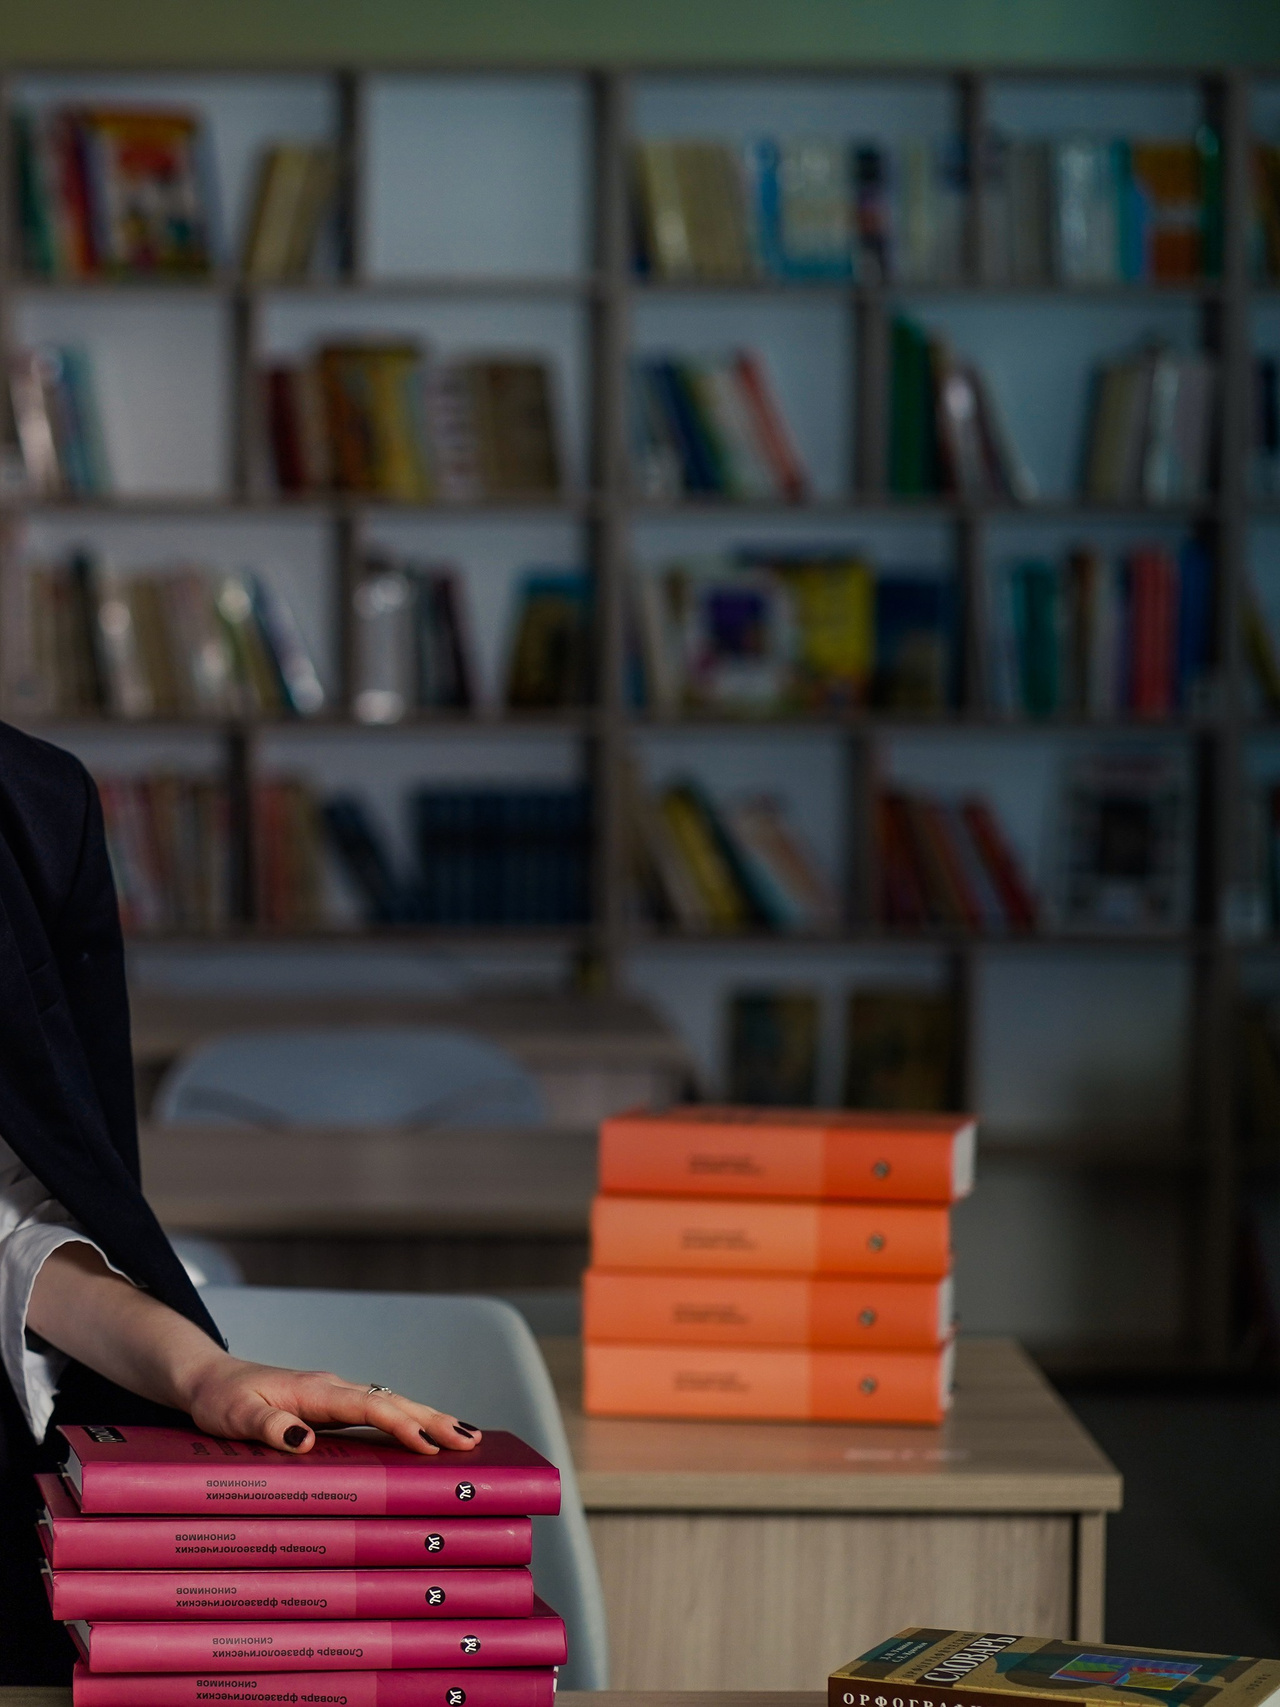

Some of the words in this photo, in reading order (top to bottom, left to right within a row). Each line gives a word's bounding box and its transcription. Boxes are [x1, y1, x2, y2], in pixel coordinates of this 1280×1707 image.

[206, 1479, 267, 1488] синонимов
[205, 1490, 309, 1502] фразеологических
[310, 1490, 358, 1503] Словарь
[175, 1533, 237, 1542] синонимов
[175, 1543, 278, 1555] фразеологических
[279, 1543, 327, 1555] Словарь
[175, 1586, 238, 1595] синонимов
[176, 1597, 279, 1609] фразеологических
[280, 1597, 328, 1609] Словарь
[212, 1636, 273, 1645] синонимов
[212, 1647, 315, 1659] фразеологических
[316, 1646, 364, 1658] Словарь
[924, 1636, 1017, 1681] СЛОВАРЬ
[196, 1679, 258, 1689] синонимов
[196, 1692, 299, 1704] фразеологических
[300, 1692, 348, 1706] Словарь
